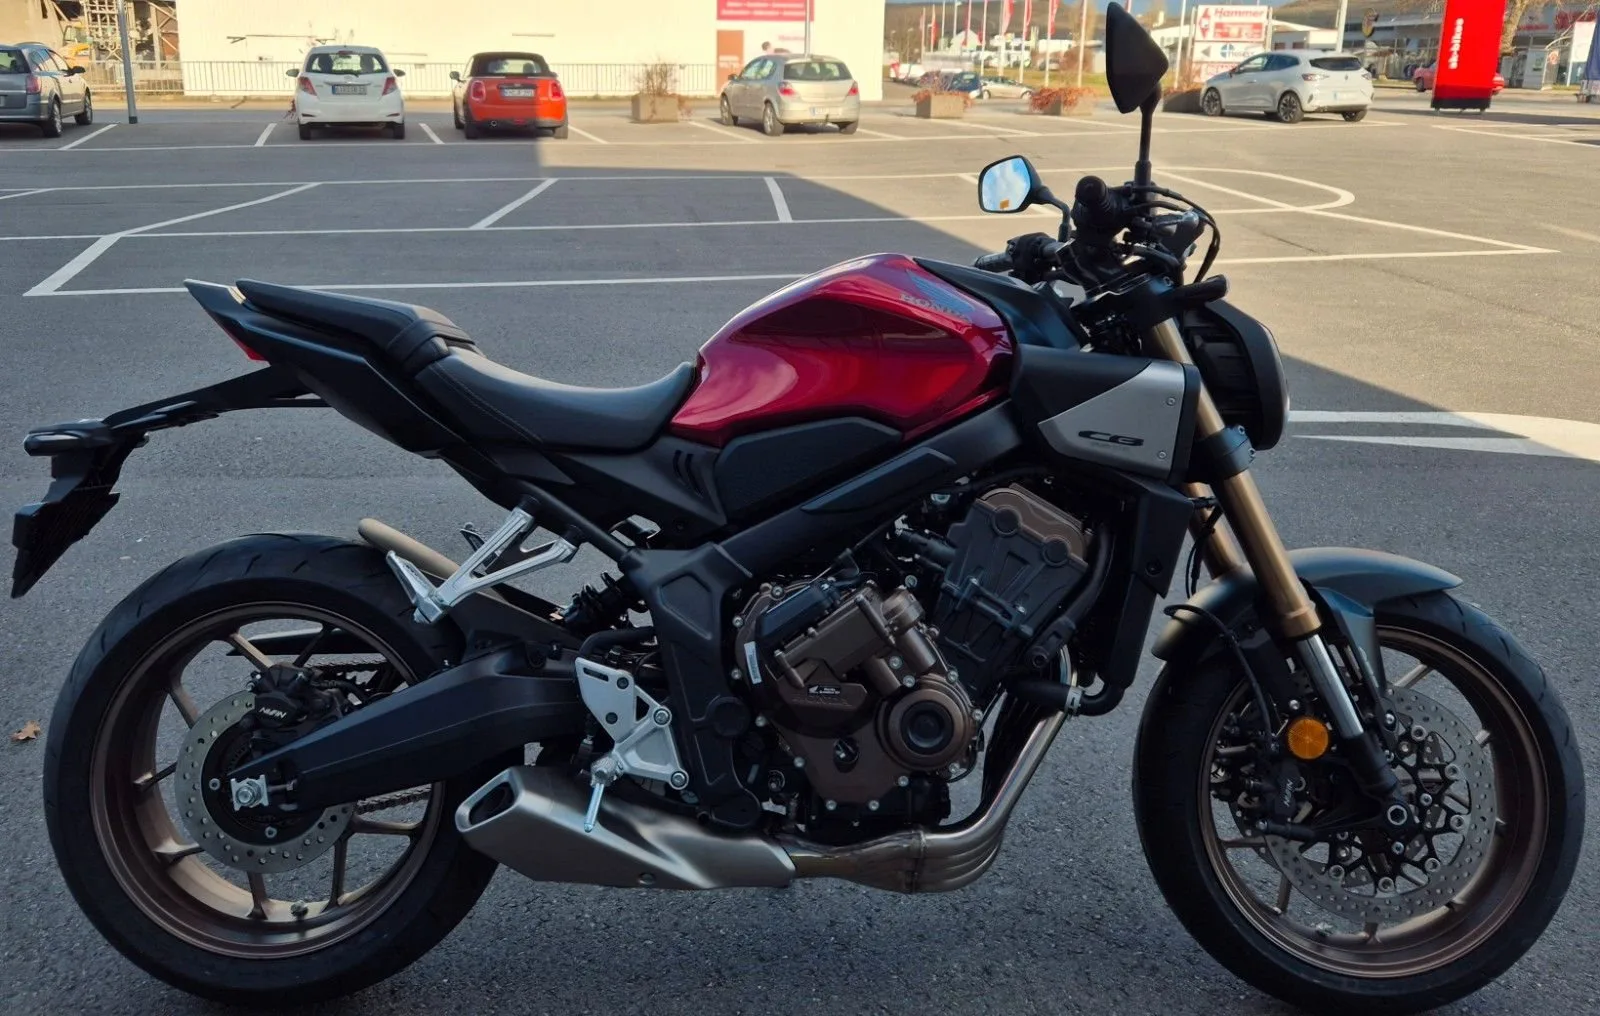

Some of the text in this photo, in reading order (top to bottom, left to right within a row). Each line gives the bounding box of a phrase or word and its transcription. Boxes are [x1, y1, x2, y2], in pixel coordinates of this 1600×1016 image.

[1214, 8, 1264, 20] Hammer
[899, 292, 971, 322] HONDA
[1078, 431, 1145, 446] CB
